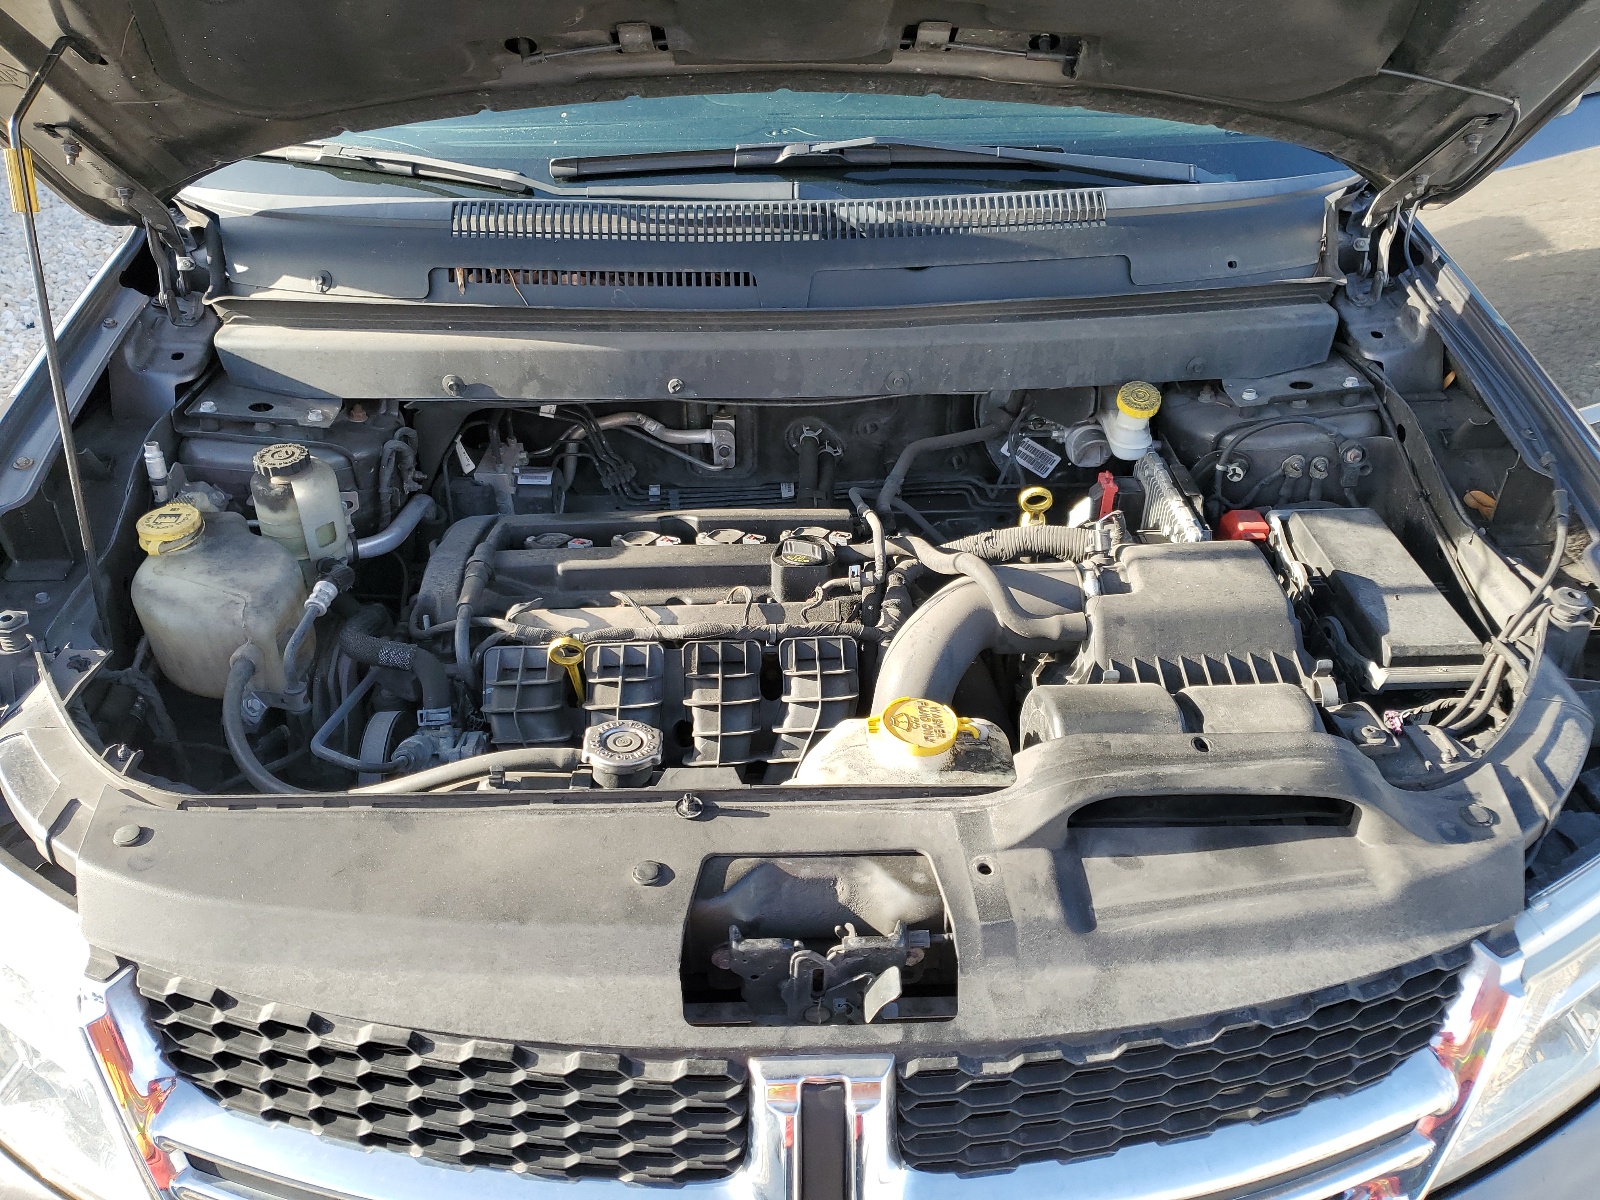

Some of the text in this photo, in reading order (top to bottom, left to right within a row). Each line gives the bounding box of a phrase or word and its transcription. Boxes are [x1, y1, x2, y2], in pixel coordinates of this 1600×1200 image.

[916, 700, 937, 744] FLUID ONLY
[929, 706, 947, 739] WASHER
